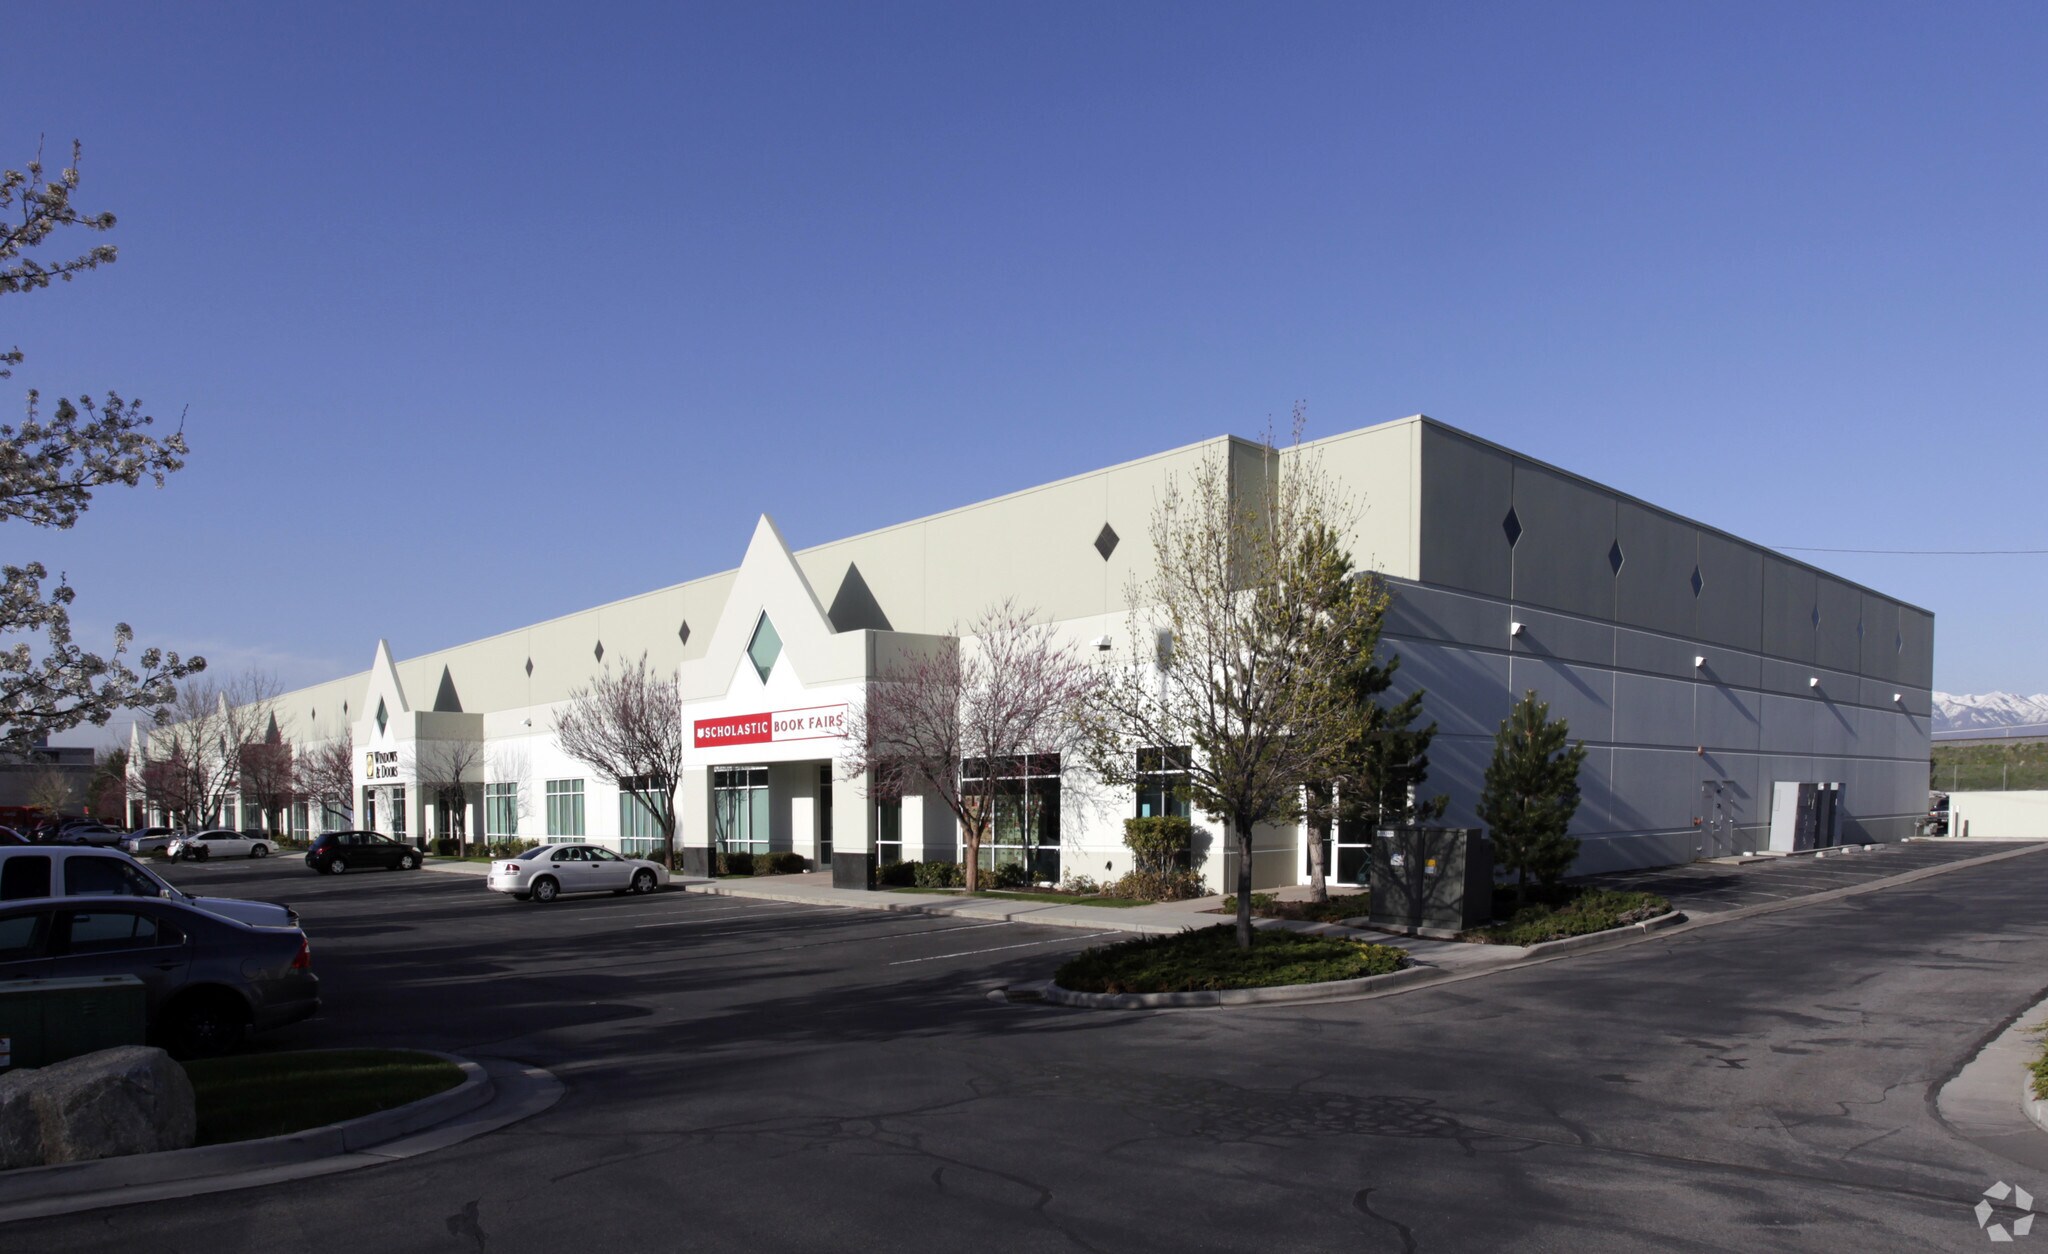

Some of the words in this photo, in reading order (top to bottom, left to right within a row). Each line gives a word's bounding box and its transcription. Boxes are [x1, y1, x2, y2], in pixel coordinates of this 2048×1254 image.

[705, 721, 768, 738] SCHOLASTIC
[774, 718, 804, 732] BOOK
[809, 714, 843, 729] FAIRS
[376, 766, 380, 779] &
[382, 765, 398, 778] DOORS
